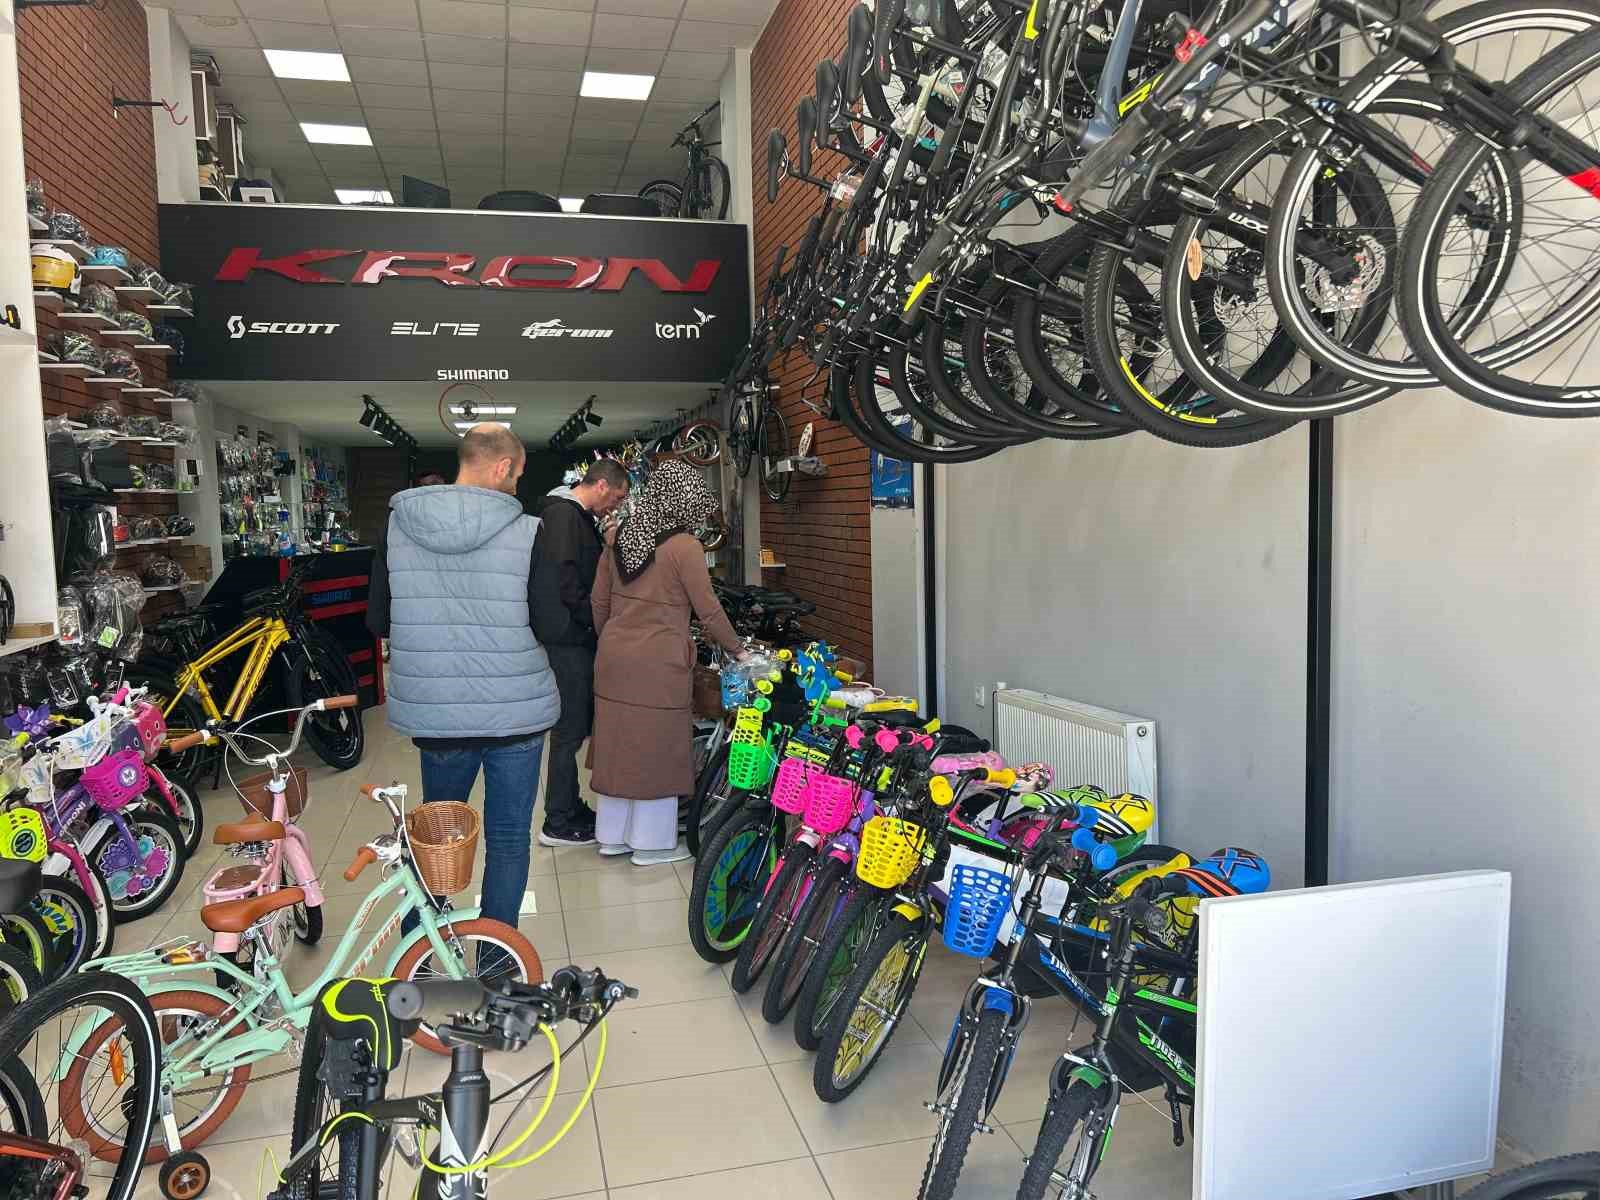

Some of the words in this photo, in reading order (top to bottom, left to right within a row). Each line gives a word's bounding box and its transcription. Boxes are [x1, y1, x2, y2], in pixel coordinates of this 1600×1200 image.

[1228, 212, 1269, 234] OOM
[214, 247, 722, 292] KRON
[248, 322, 341, 335] SCOTT
[655, 322, 700, 339] tern
[437, 369, 509, 381] SHIMANO
